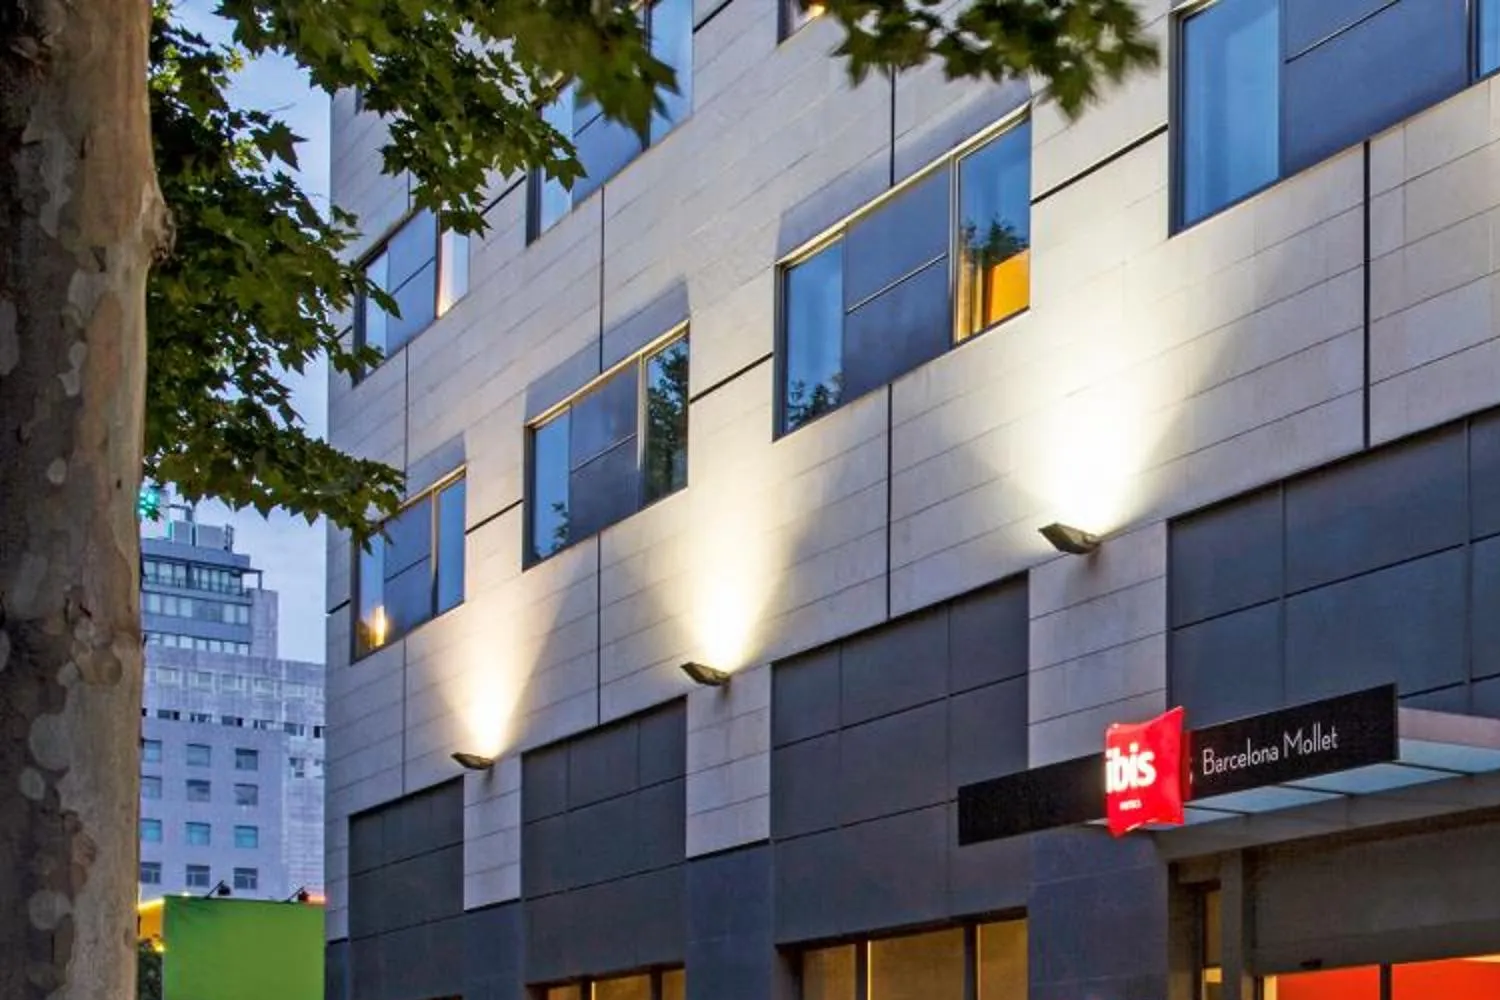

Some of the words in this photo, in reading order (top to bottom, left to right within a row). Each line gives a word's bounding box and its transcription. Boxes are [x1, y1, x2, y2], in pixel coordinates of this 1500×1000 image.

[1105, 741, 1157, 793] ibis
[1203, 737, 1279, 775] Barcelona
[1283, 721, 1338, 758] Mollet
